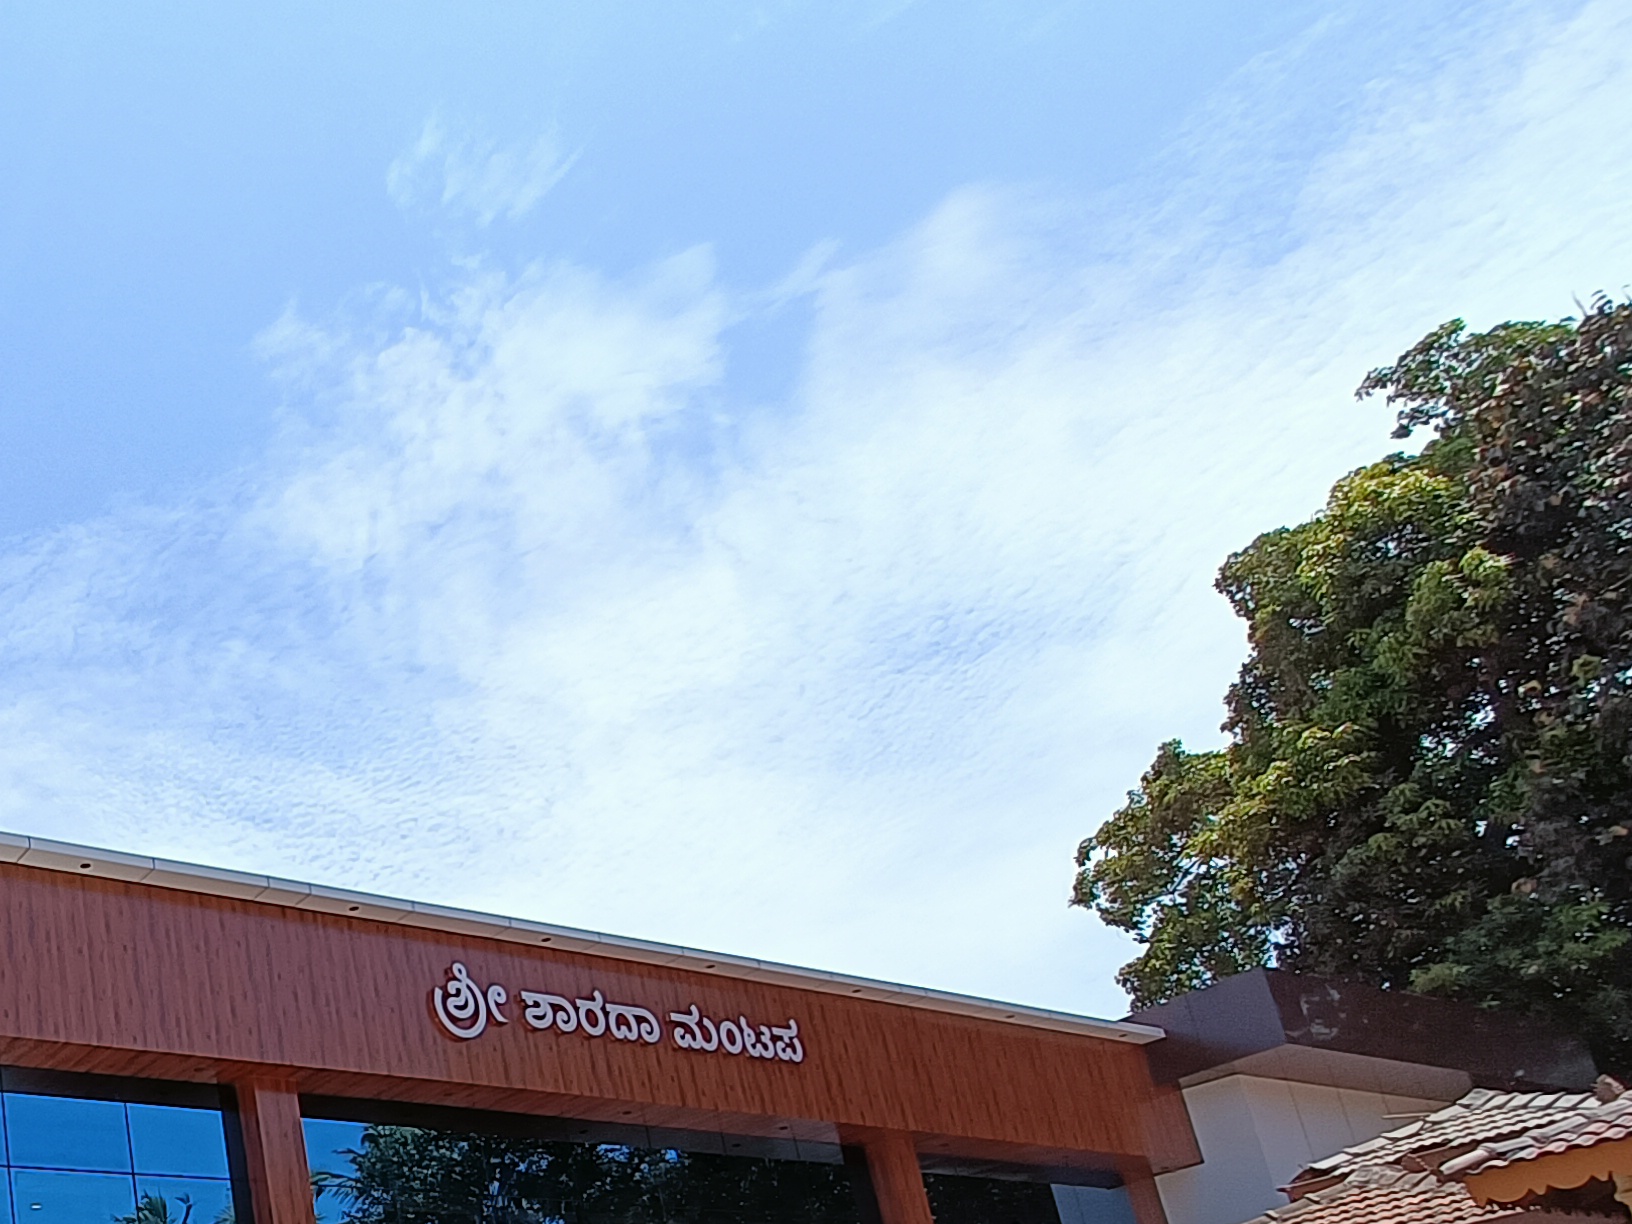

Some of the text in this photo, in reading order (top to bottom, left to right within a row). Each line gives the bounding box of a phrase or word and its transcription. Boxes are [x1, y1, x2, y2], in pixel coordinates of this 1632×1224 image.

[434, 961, 806, 1063] ಶ್ರೀ ಶಾರದಾ ಮಂಟಪ
